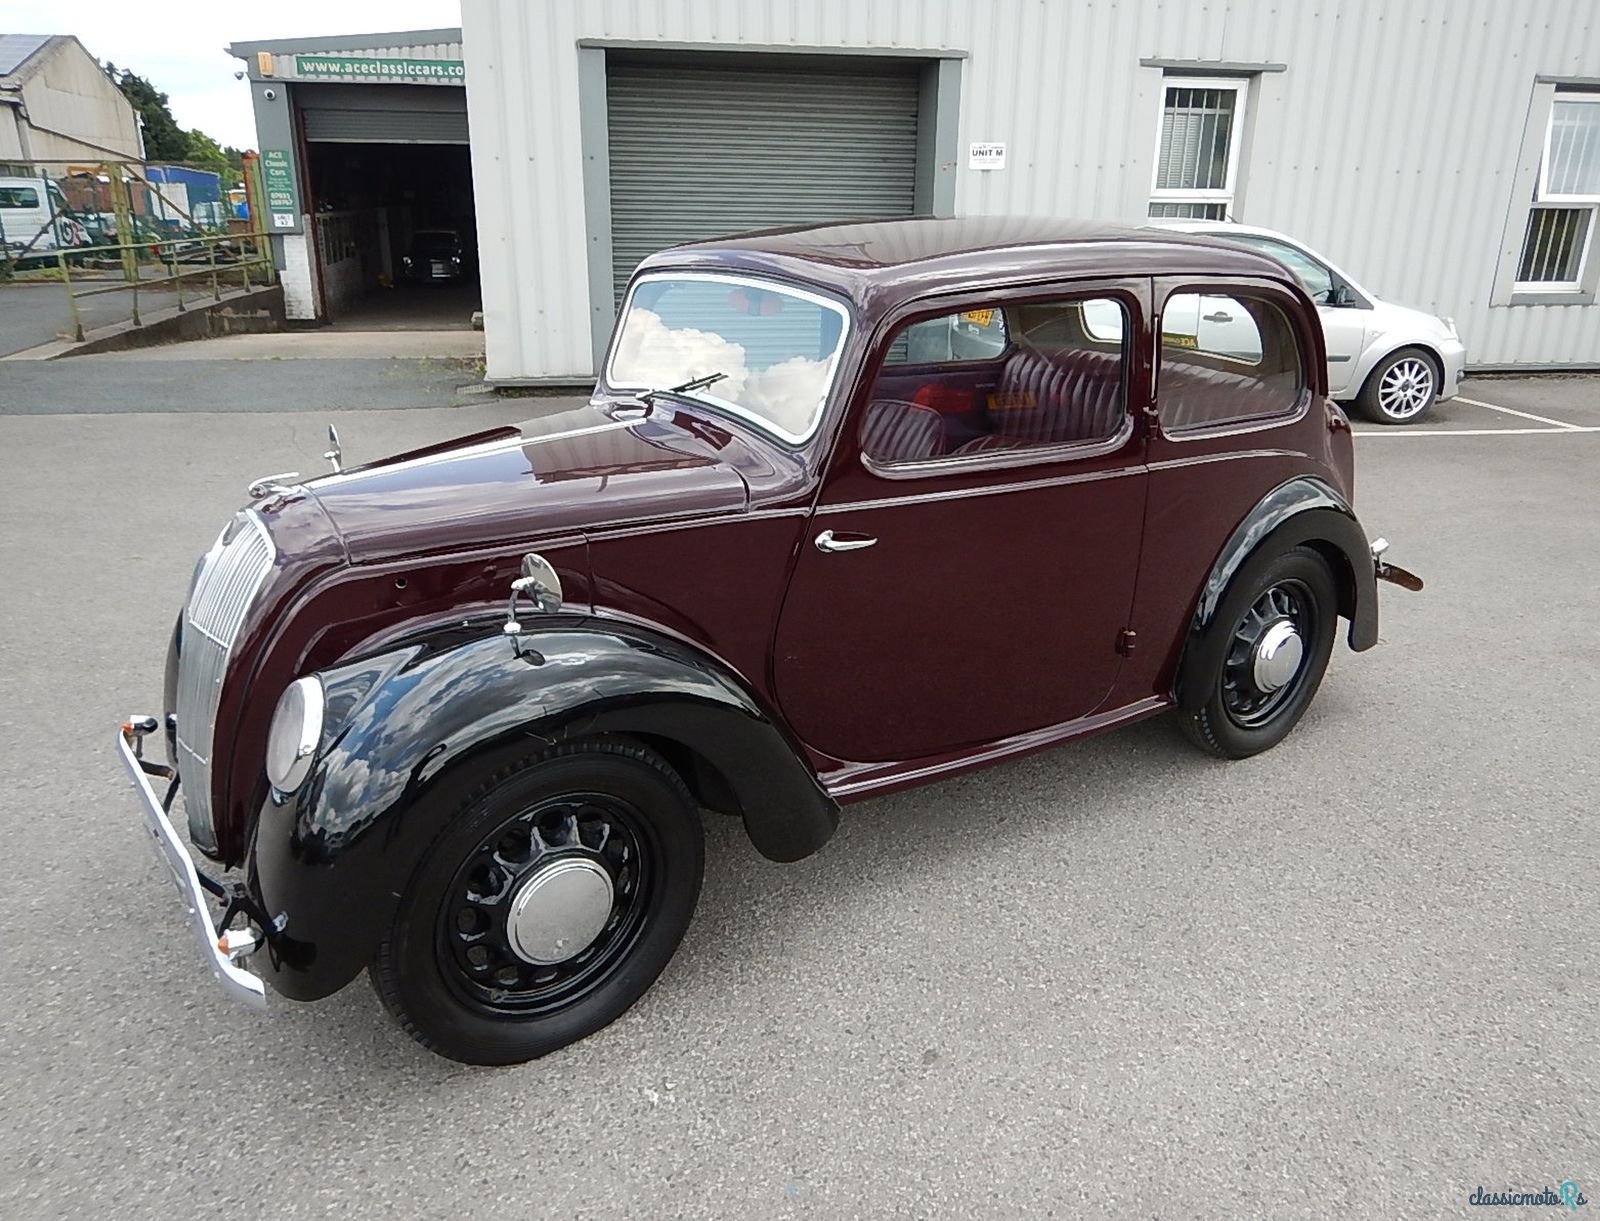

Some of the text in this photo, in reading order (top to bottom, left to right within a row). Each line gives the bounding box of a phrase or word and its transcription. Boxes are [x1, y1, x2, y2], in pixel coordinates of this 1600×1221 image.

[303, 60, 464, 76] www.aceclassiccars.co
[972, 149, 1004, 157] UNIT M
